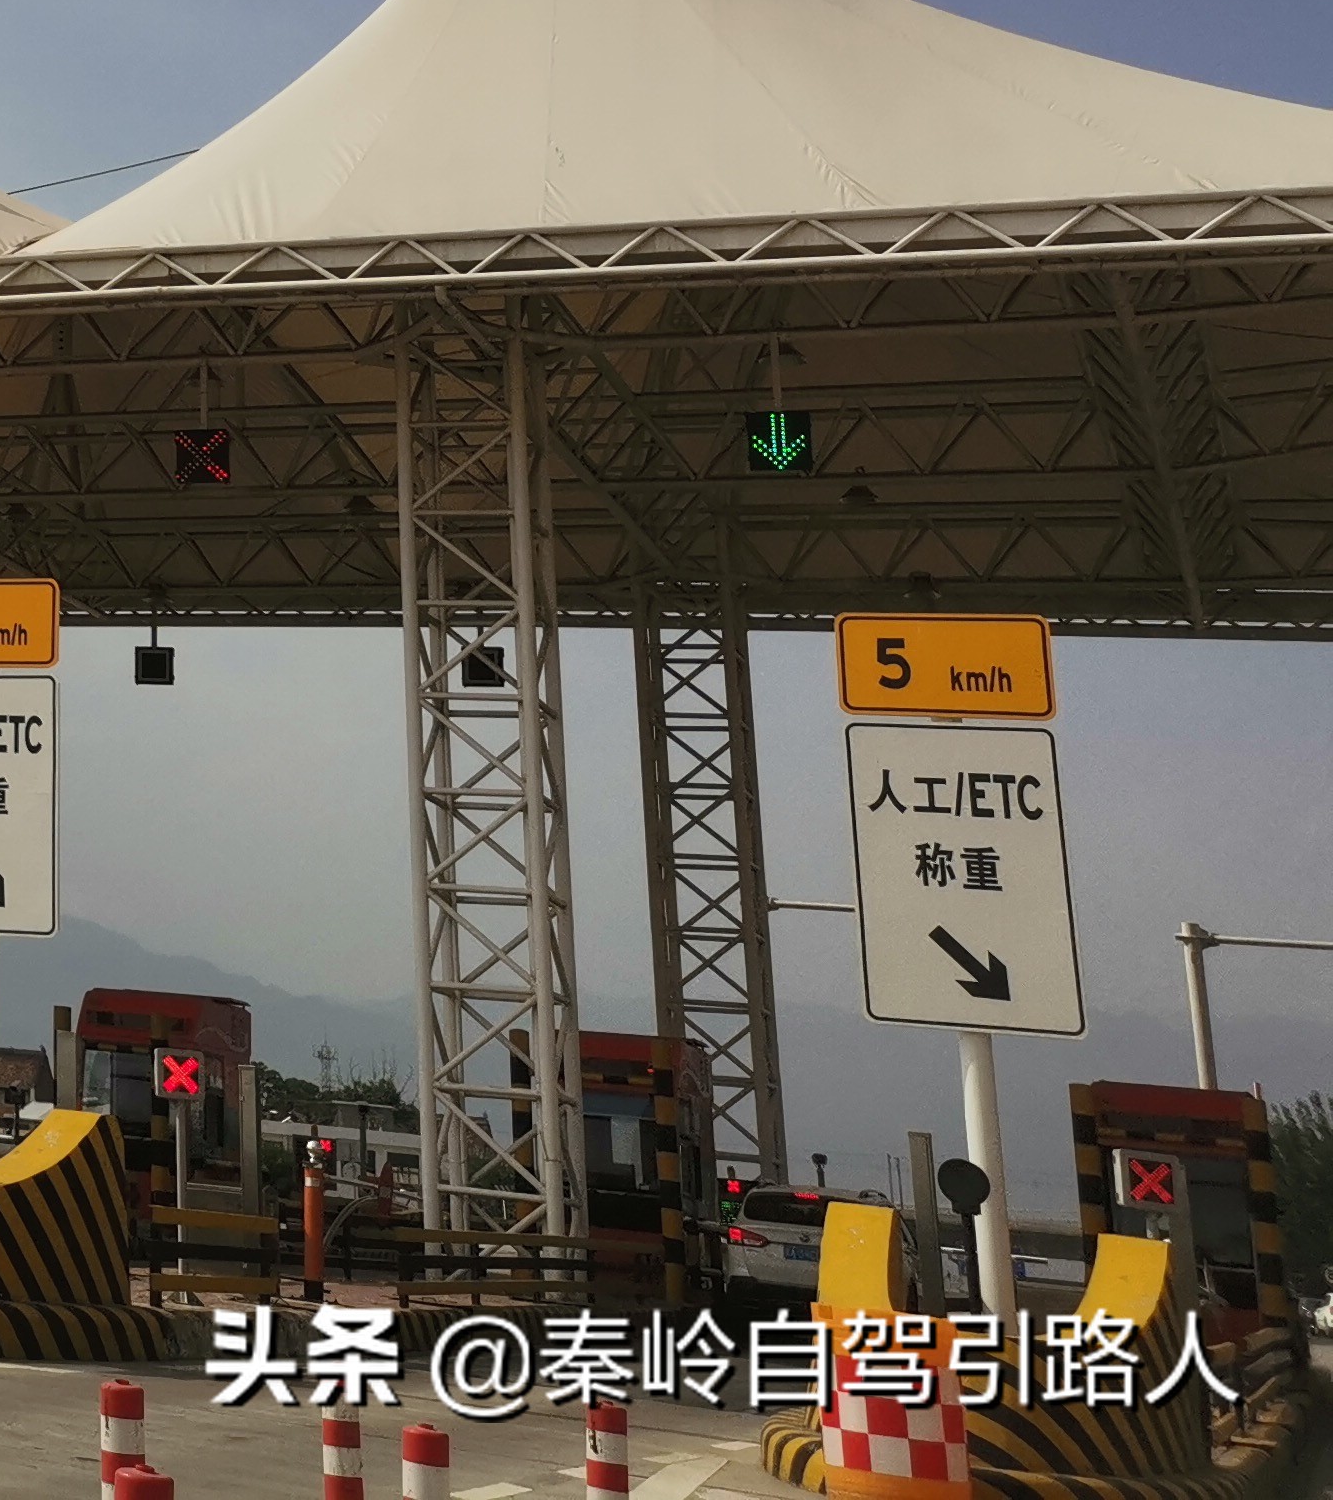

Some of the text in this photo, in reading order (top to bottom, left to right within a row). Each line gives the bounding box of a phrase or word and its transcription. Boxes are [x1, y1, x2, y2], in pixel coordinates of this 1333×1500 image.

[876, 637, 1013, 693] 5 km/h
[866, 768, 1044, 821] 人工/ETC
[913, 841, 1003, 892] 称重
